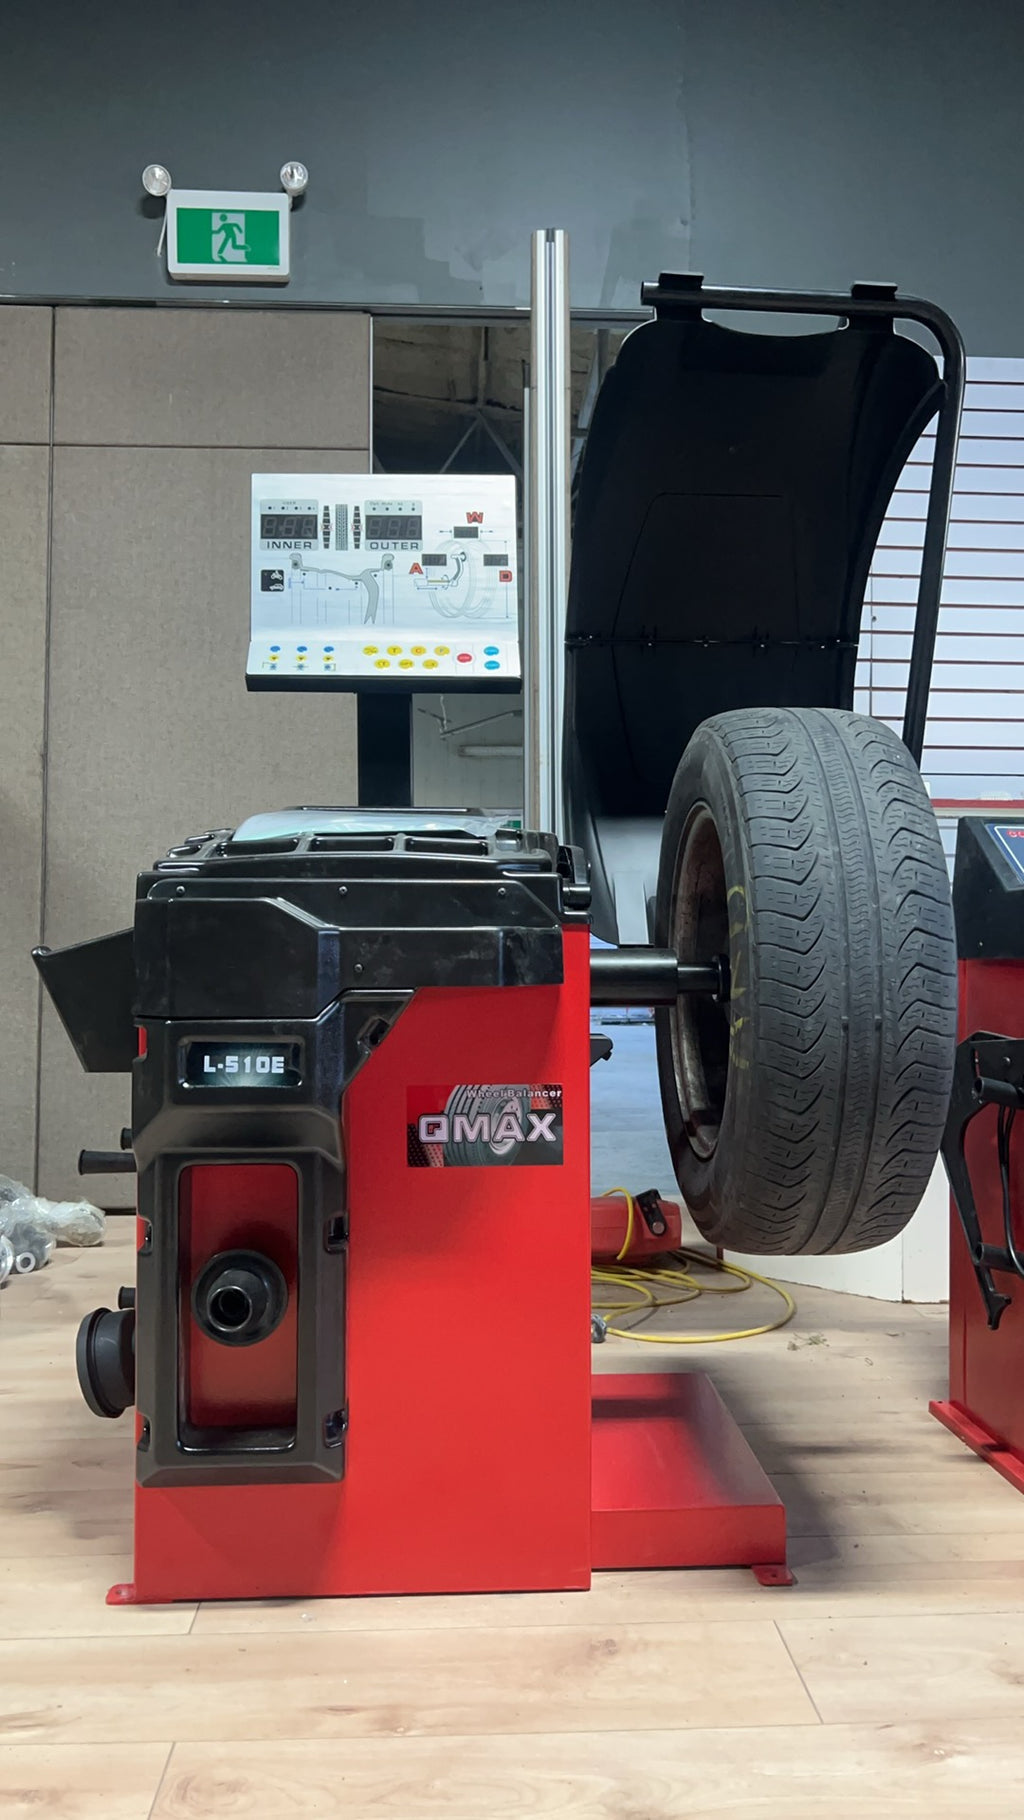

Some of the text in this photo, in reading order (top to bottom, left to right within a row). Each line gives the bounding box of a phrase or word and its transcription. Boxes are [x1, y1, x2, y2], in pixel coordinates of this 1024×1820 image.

[466, 511, 484, 524] W
[267, 541, 312, 550] INNER
[370, 542, 419, 550] OUTER
[409, 562, 424, 575] A
[203, 1055, 285, 1074] L-510E
[466, 1089, 562, 1099] Wheel Balancer
[419, 1112, 557, 1144] QMAX
